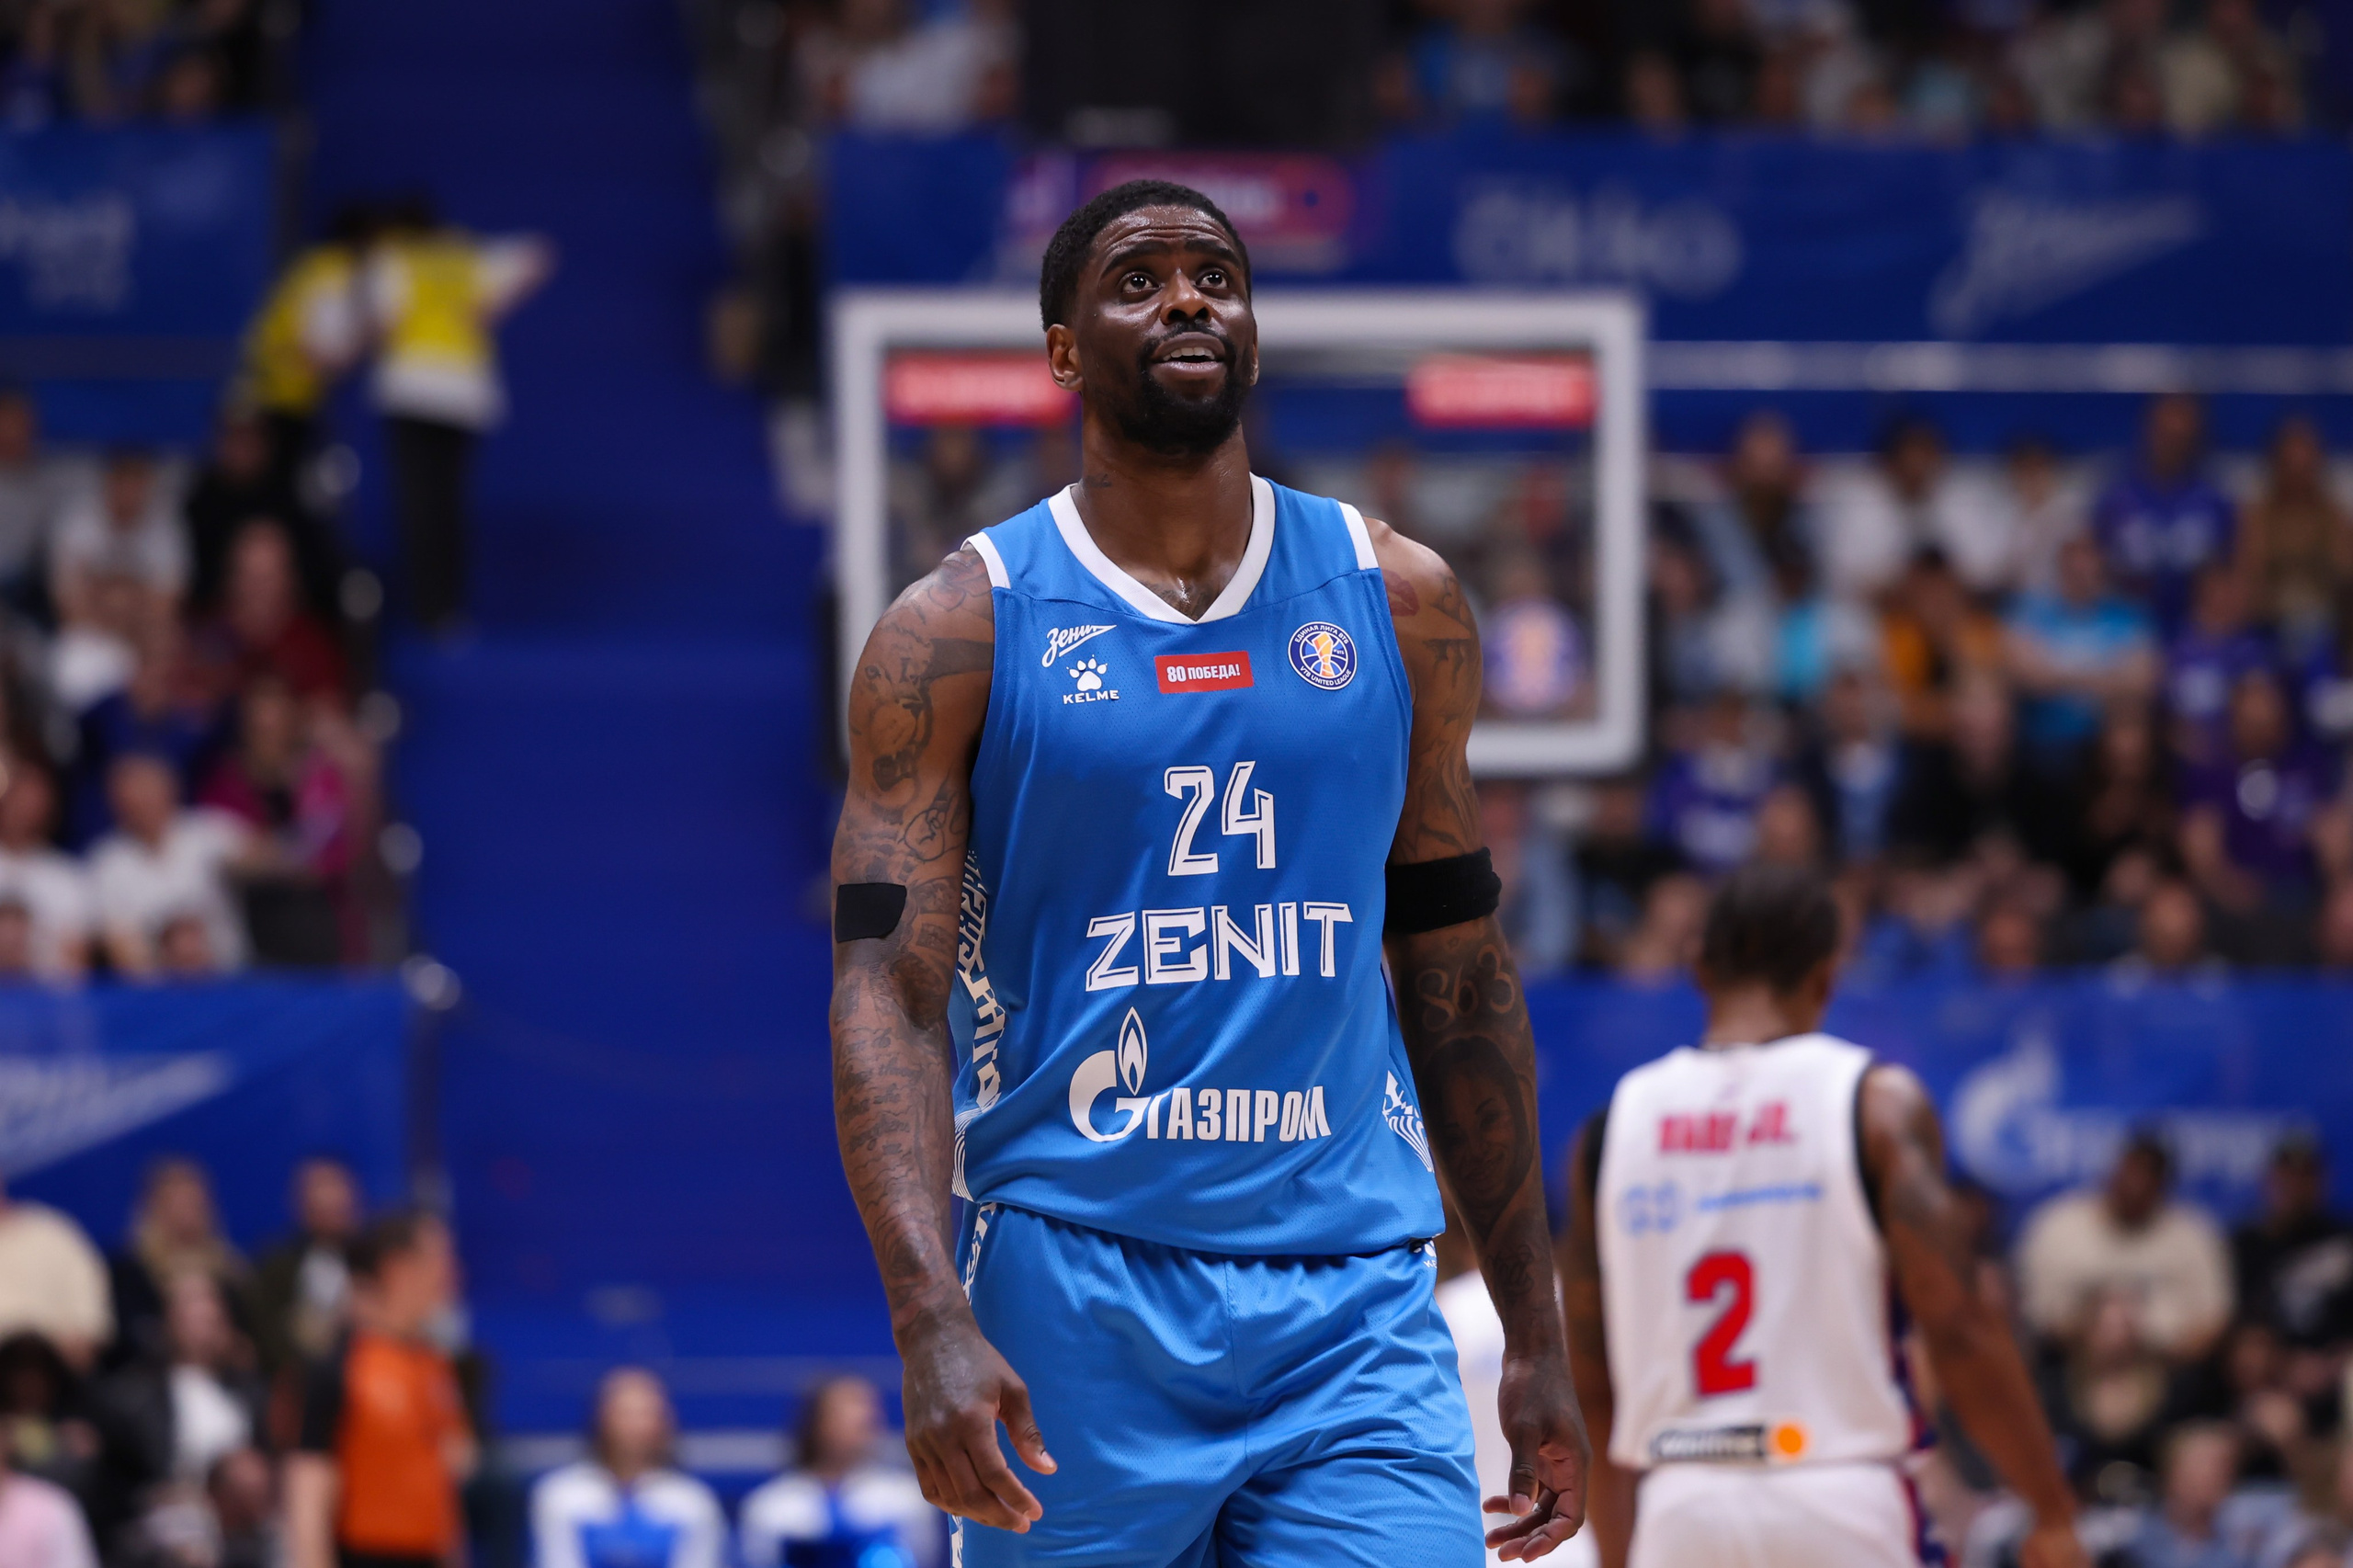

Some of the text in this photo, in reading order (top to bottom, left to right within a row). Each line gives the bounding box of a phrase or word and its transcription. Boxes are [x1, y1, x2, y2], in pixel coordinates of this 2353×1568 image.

[1294, 625, 1349, 644] ЕДИНАЯ ЛИГА ВТБ
[1166, 664, 1241, 683] 80 ПОБЕДА!
[1300, 665, 1352, 686] VTB UNITED LEAGUE
[1063, 689, 1120, 705] KELME
[1164, 760, 1277, 876] 24
[1085, 901, 1354, 992] ZENIT
[1146, 1085, 1332, 1142] ГАЗПРОМ
[1686, 1249, 1757, 1399] 2
